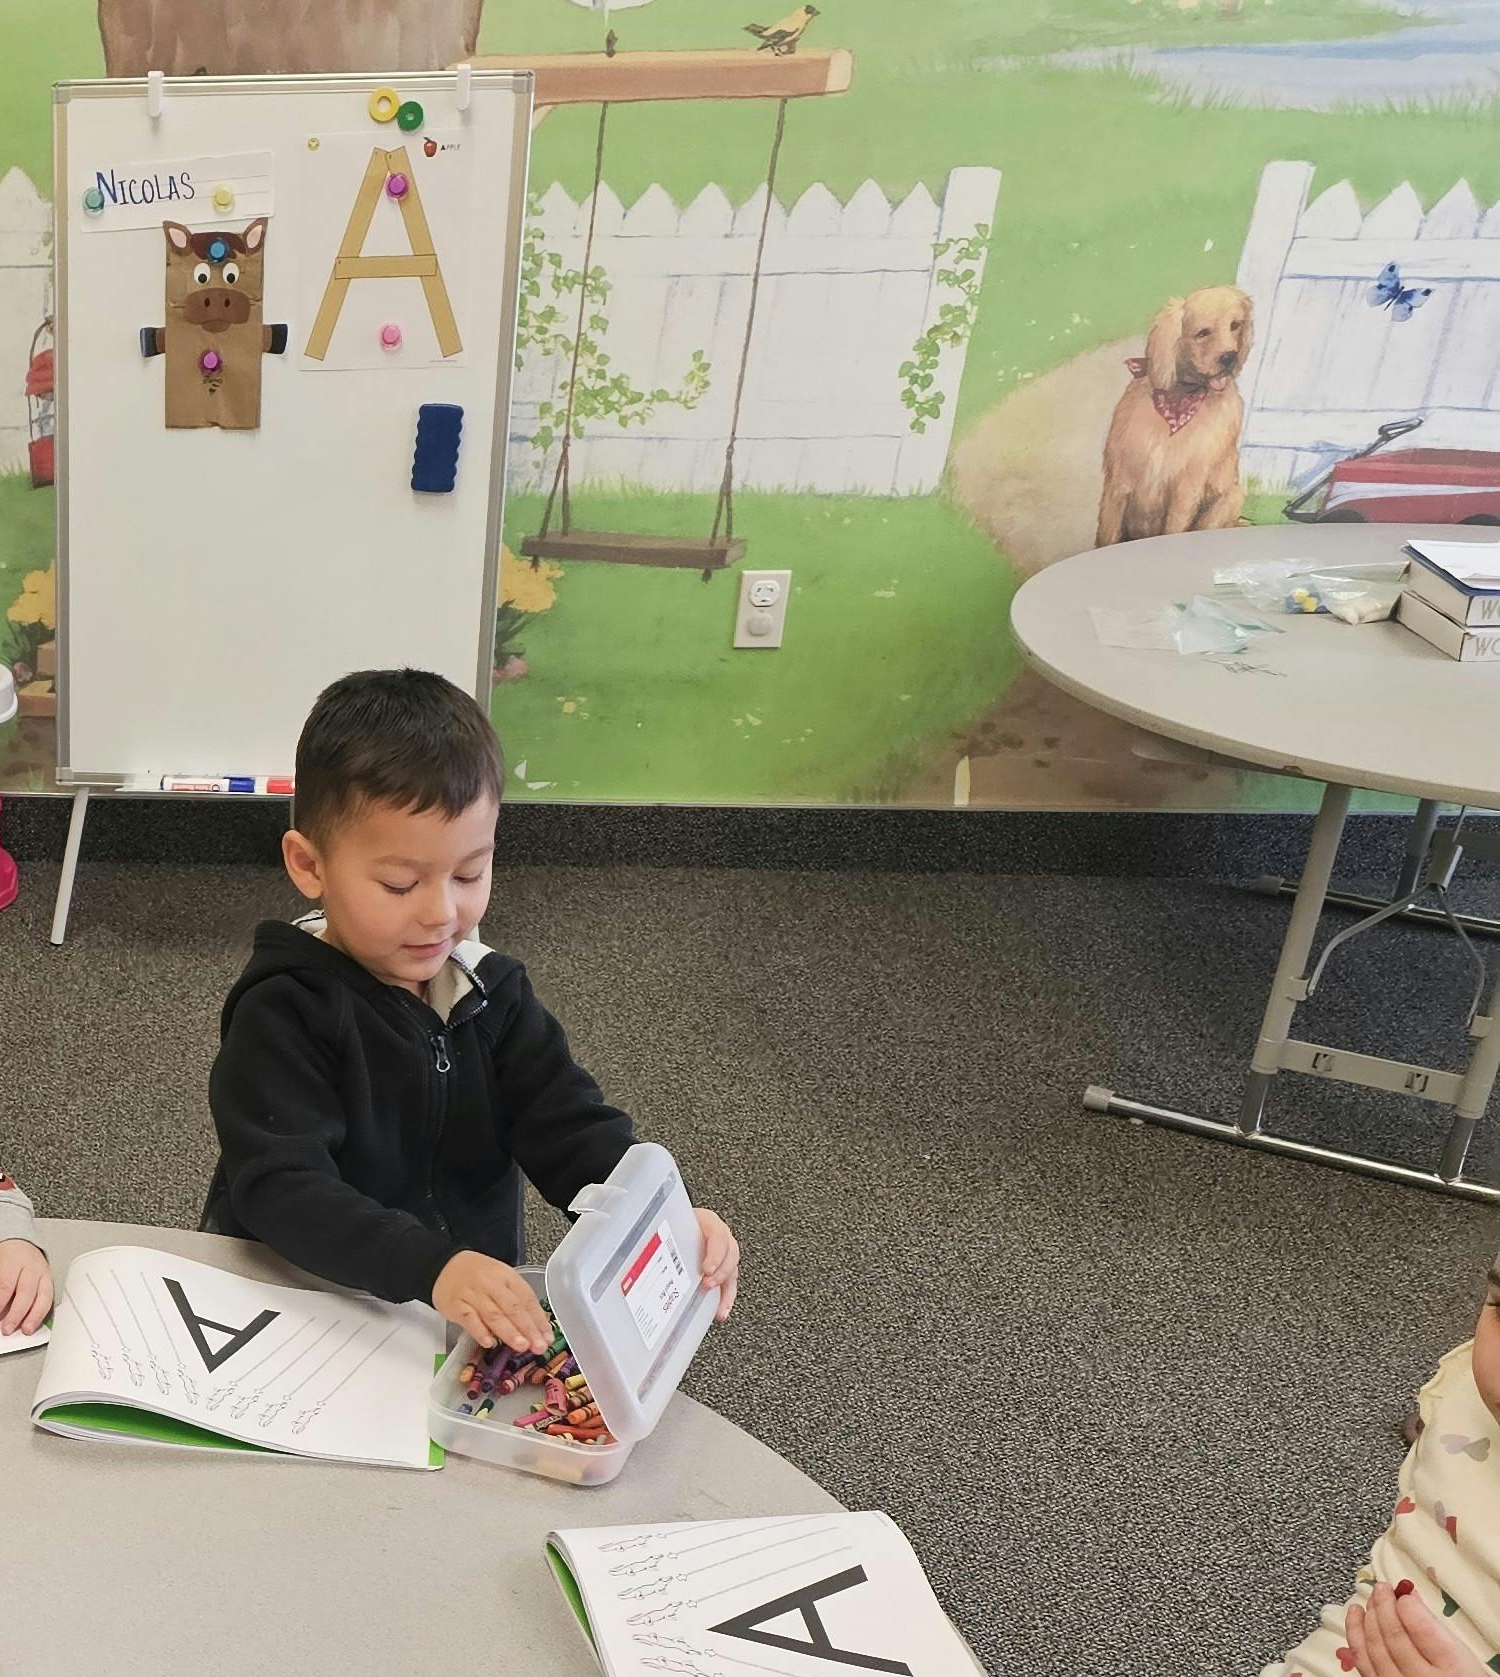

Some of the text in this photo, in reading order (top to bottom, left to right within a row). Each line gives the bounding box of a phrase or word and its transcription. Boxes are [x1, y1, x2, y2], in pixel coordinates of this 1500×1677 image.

[95, 169, 195, 205] NICOLAS
[1482, 599, 1500, 620] W
[162, 1276, 281, 1374] A
[707, 1563, 914, 1677] A
